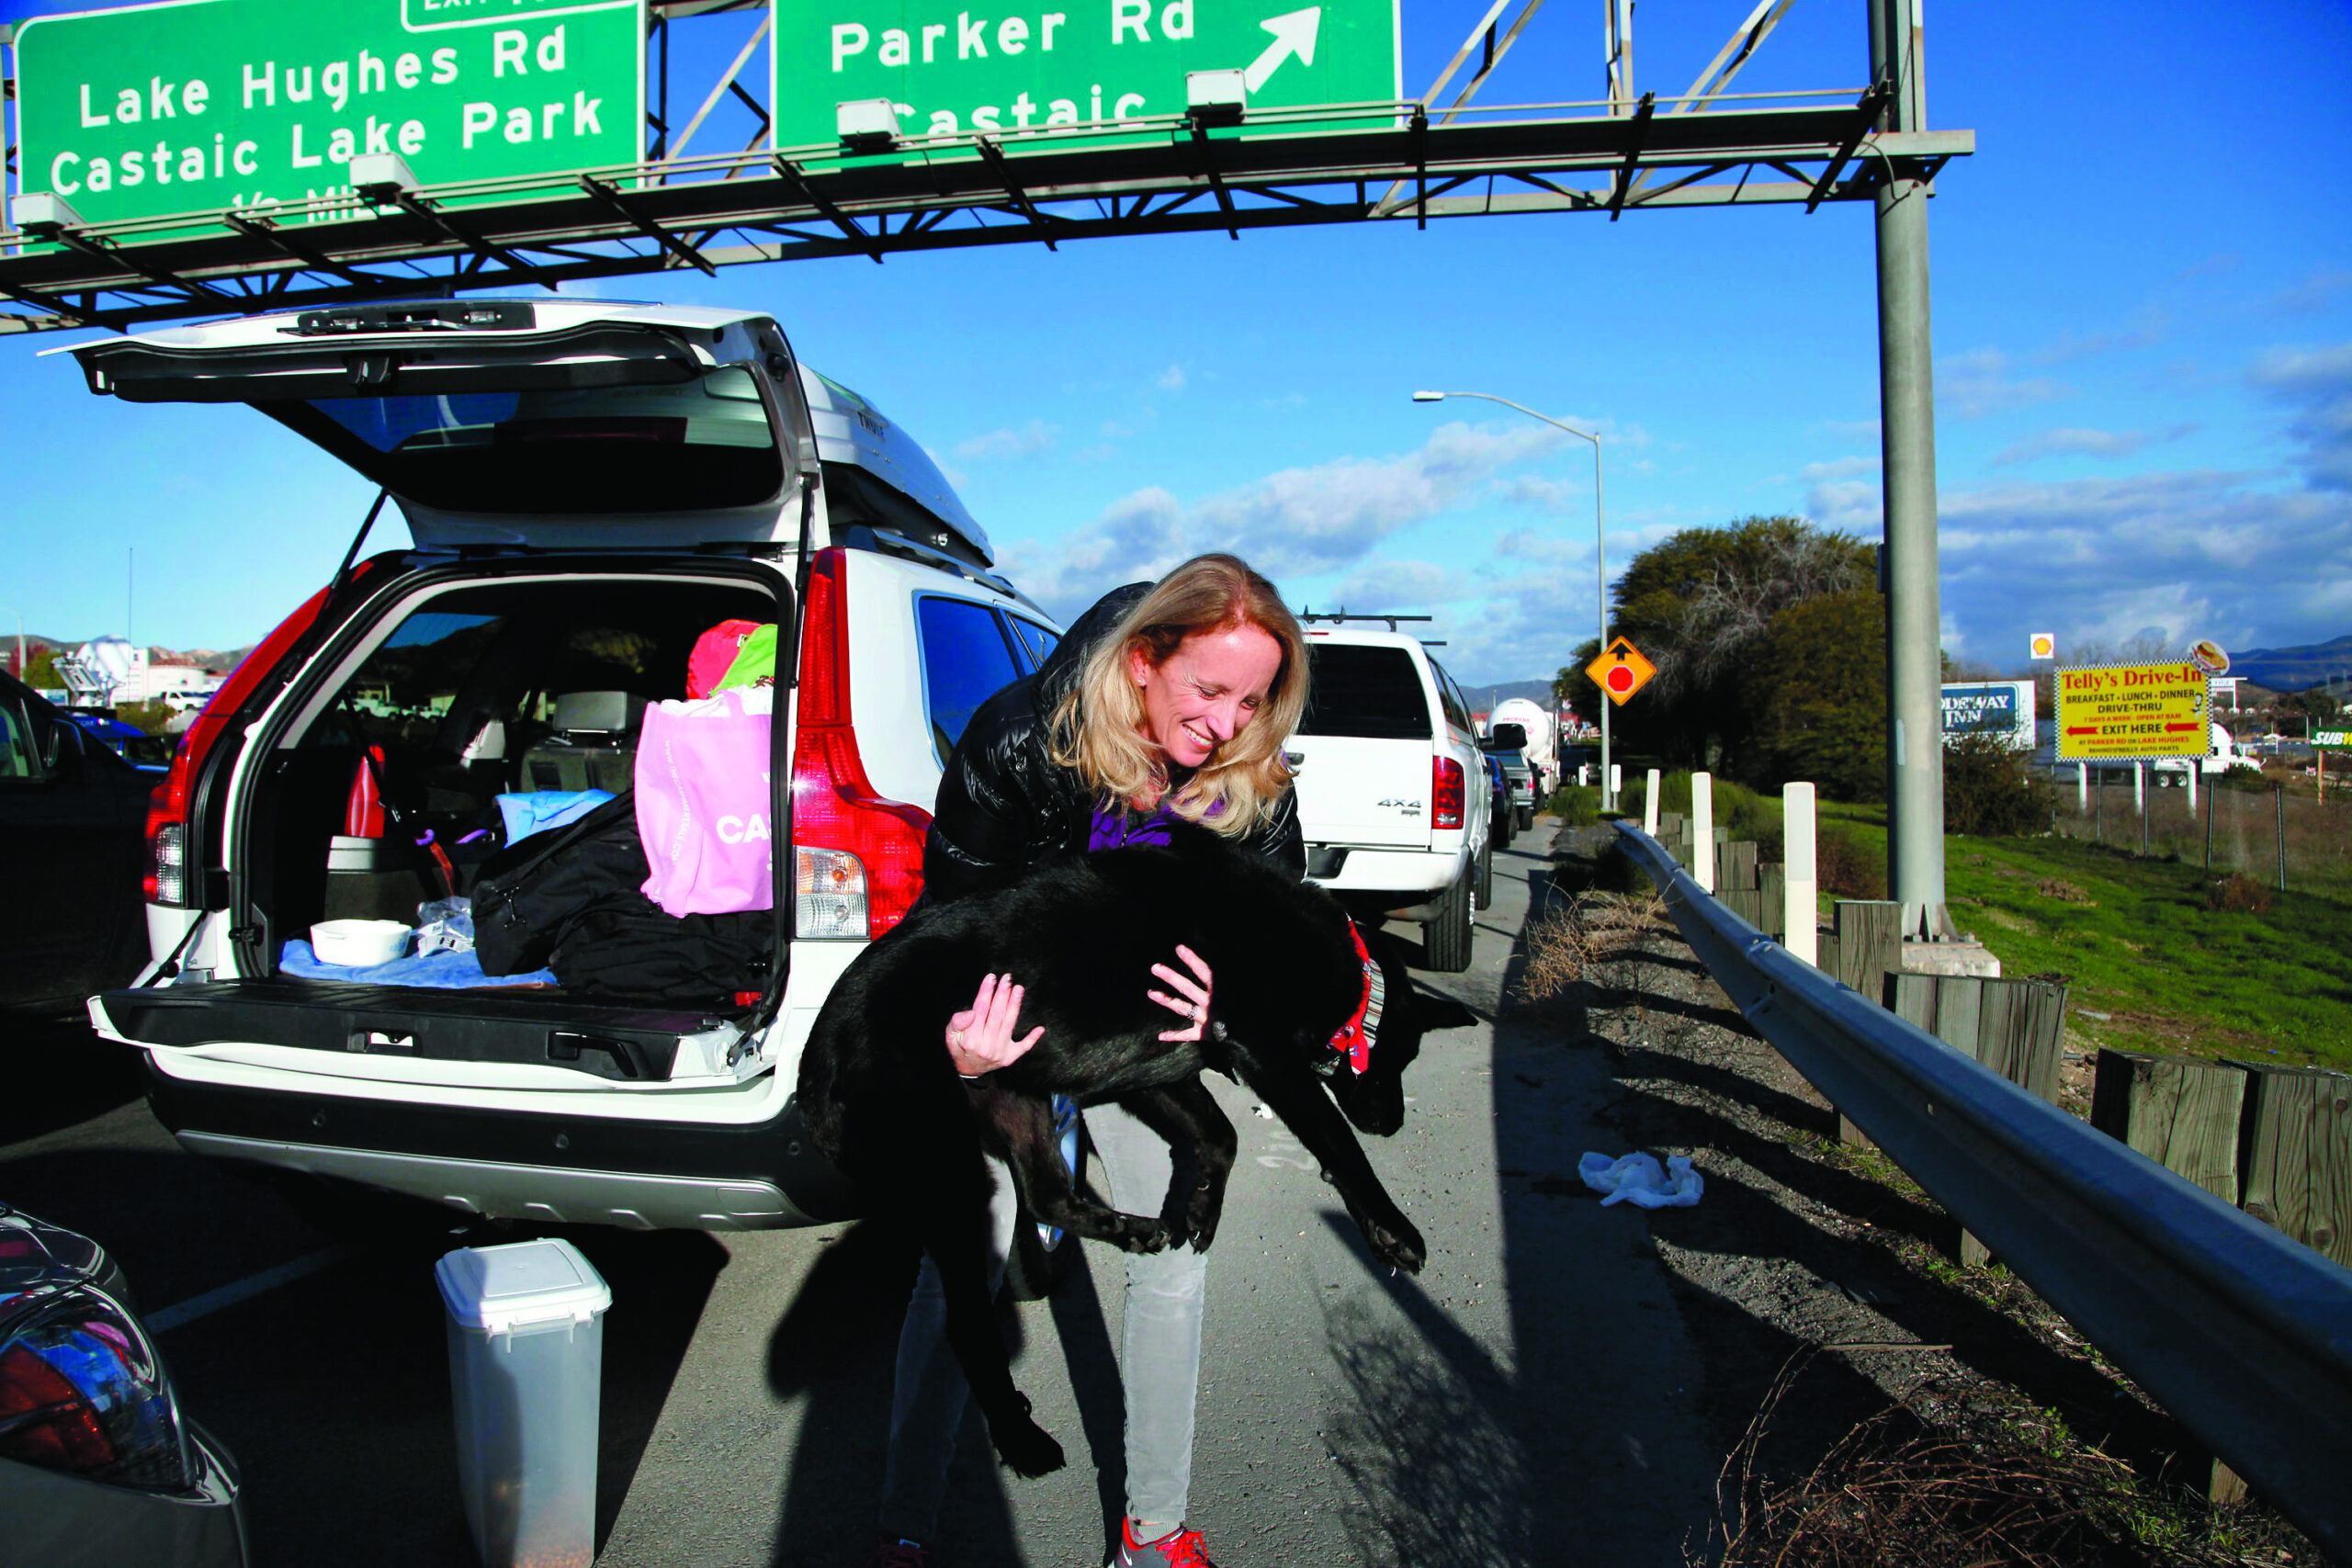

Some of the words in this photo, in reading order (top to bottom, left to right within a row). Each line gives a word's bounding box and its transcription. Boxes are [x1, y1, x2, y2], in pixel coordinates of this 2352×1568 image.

[831, 11, 1067, 73] Parker
[1111, 0, 1195, 44] Rd
[80, 75, 209, 128] Lake
[242, 47, 459, 112] Hughes
[492, 24, 566, 77] Rd
[50, 132, 259, 196] Castaic
[291, 115, 426, 168] Lake
[461, 90, 603, 149] Park
[2061, 671, 2118, 692] Telly's
[2123, 665, 2202, 686] Drive-In
[2065, 693, 2115, 704] BREAKFAST
[2121, 692, 2153, 701] LUNCH
[2159, 689, 2196, 700] DINNER
[2098, 702, 2163, 714] DRIVE-THRU
[2101, 725, 2128, 735] EXIT
[2131, 723, 2162, 734] HERE
[717, 813, 772, 844] CA
